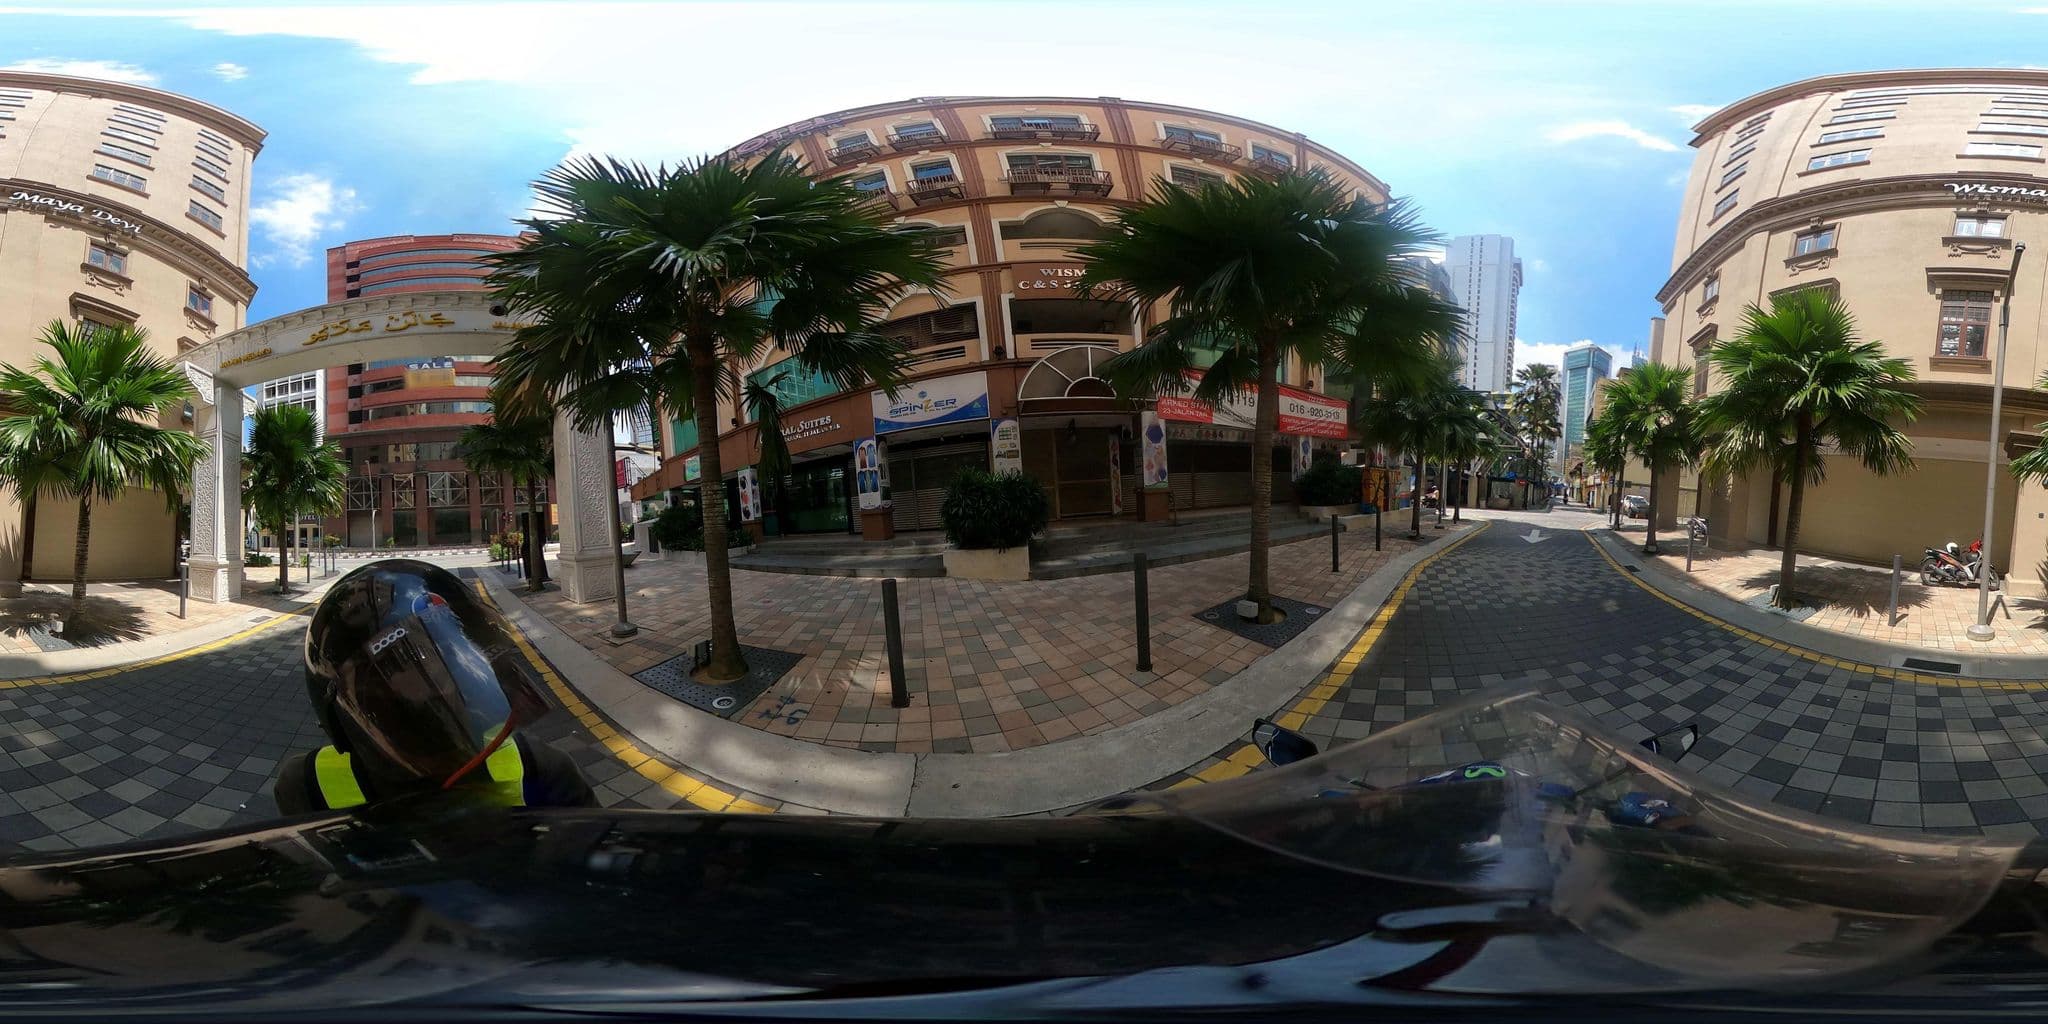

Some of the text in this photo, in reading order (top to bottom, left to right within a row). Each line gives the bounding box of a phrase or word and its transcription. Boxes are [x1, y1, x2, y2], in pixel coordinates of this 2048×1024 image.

[1944, 183, 2048, 197] Wisma
[9, 191, 143, 233] Maya Devi
[1040, 268, 1087, 277] WISM
[1018, 280, 1030, 290] C
[1033, 280, 1046, 289] &
[1049, 280, 1059, 289] S
[409, 360, 453, 370] SALE
[1289, 403, 1305, 414] 016
